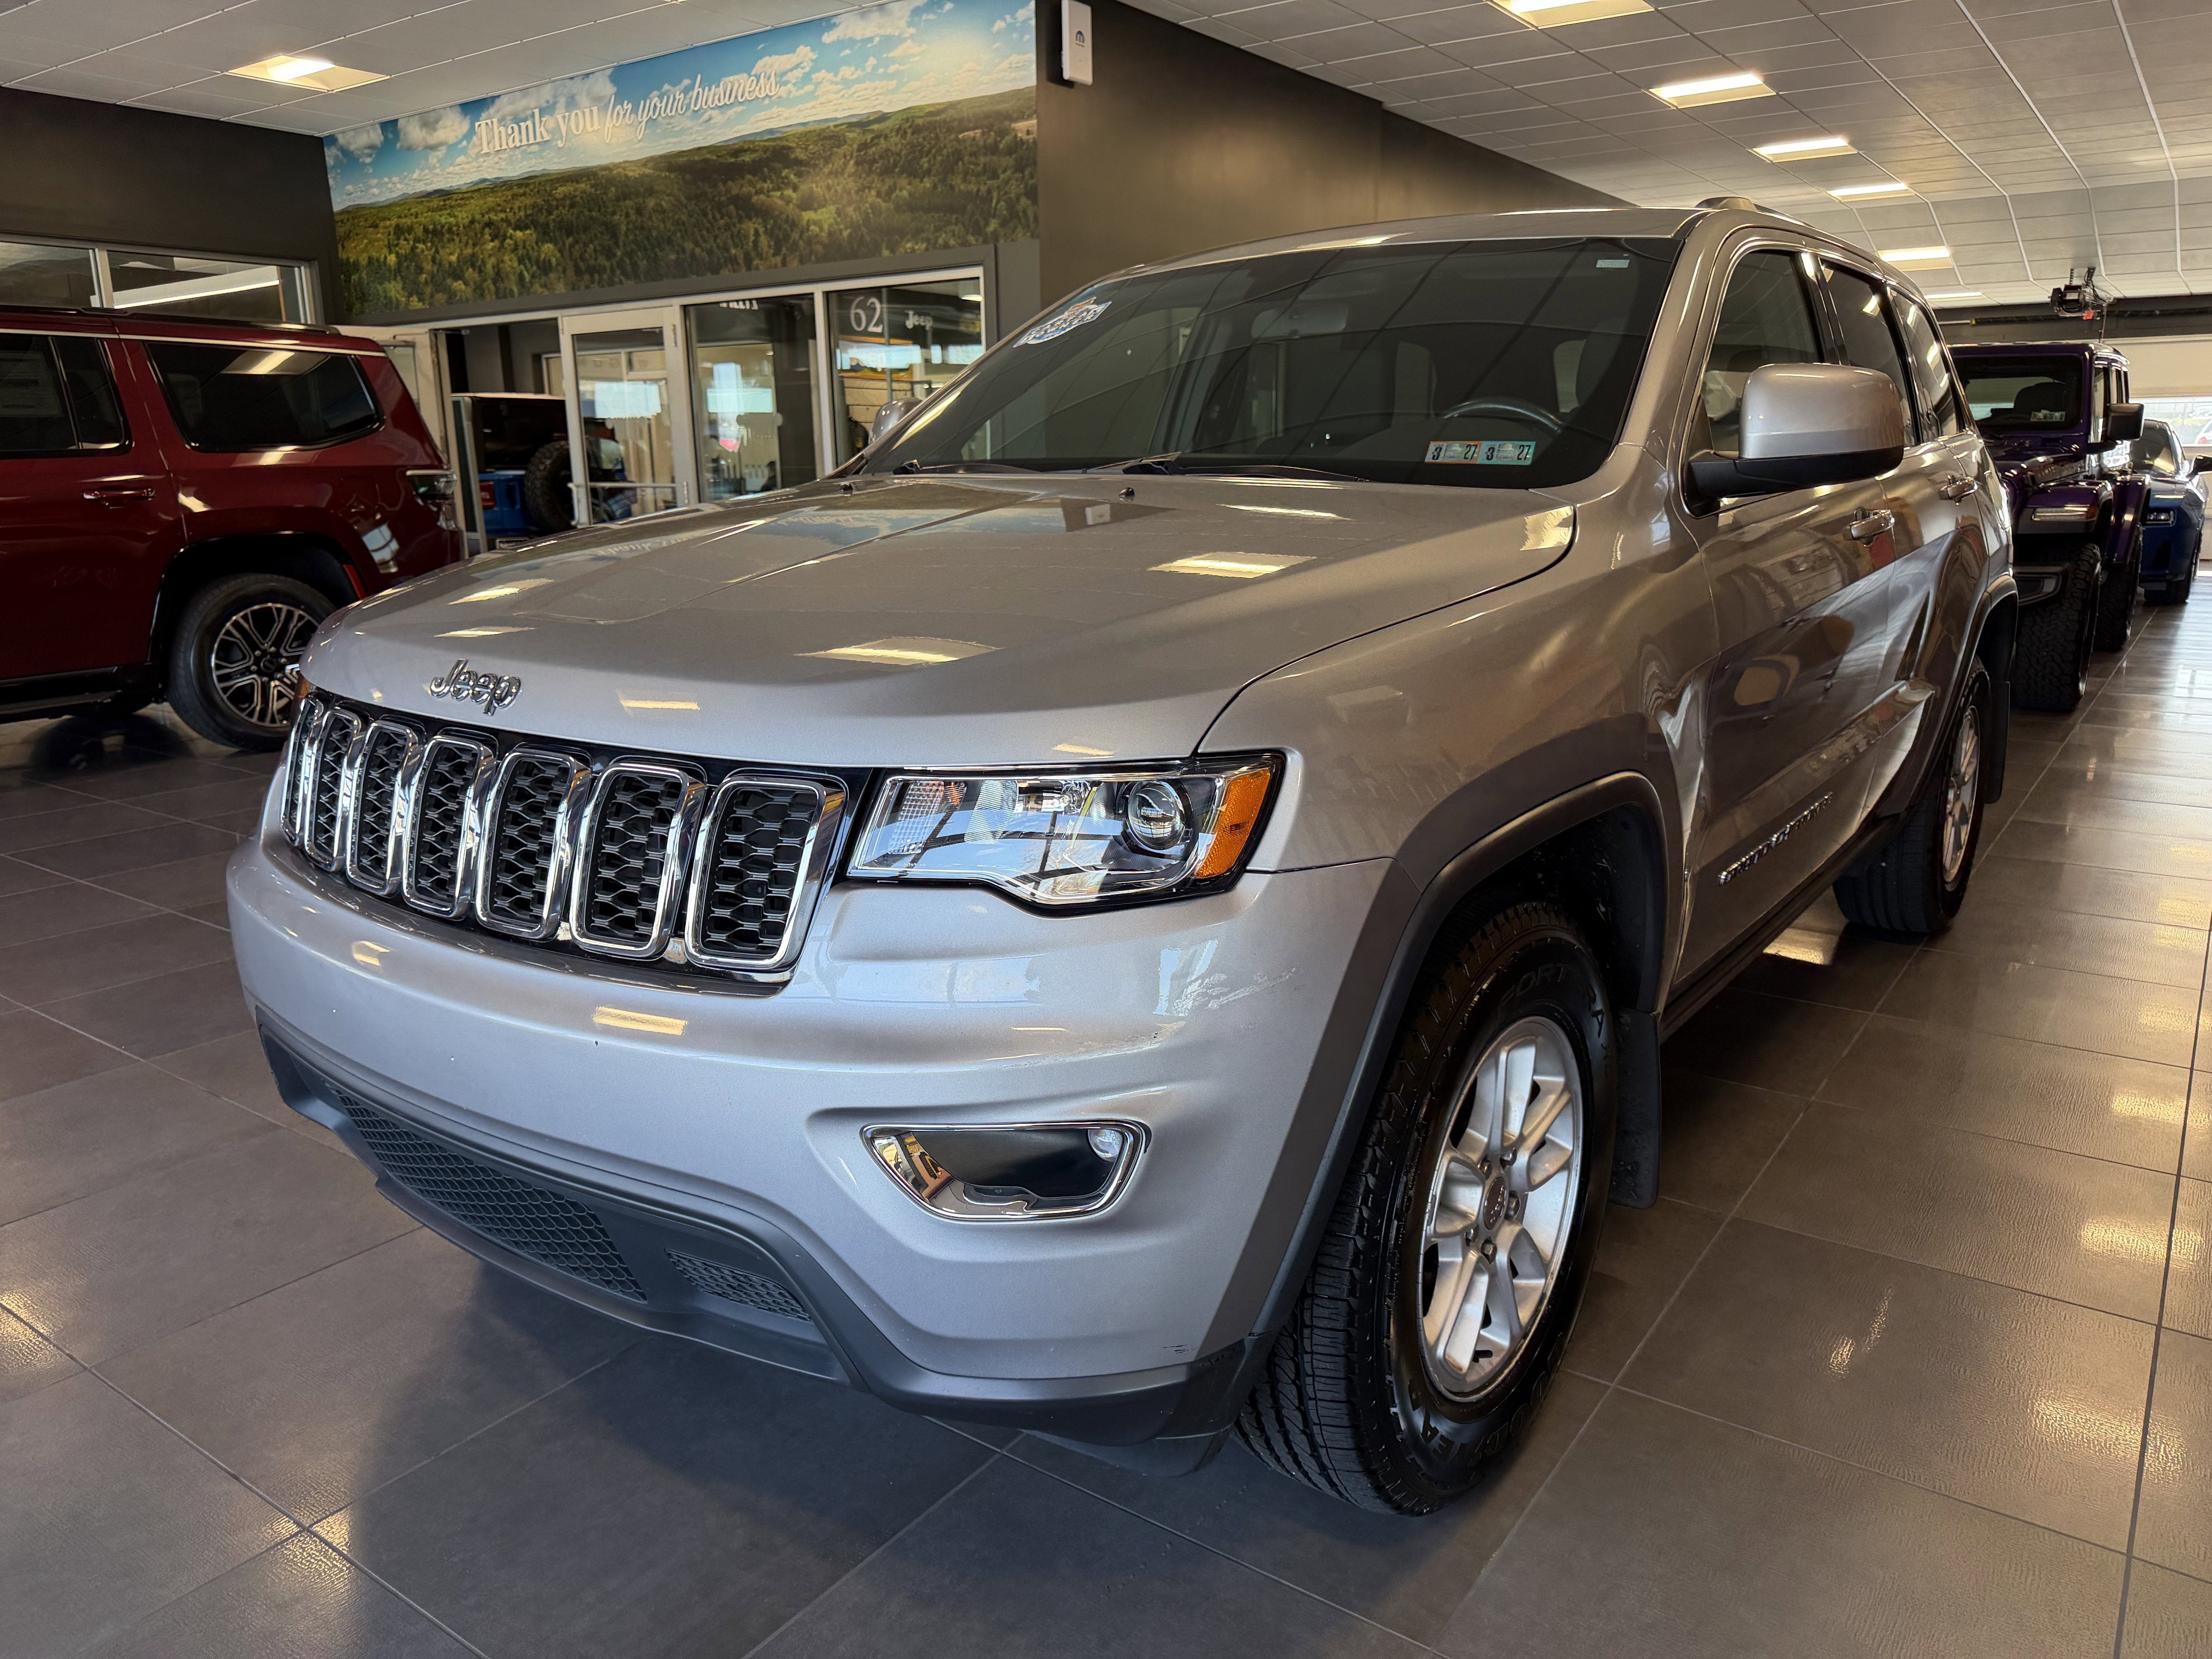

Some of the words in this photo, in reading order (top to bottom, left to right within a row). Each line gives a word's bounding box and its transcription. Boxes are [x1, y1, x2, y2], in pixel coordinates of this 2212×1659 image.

[475, 108, 551, 154] Thank
[555, 106, 601, 148] you
[604, 94, 635, 144] for
[636, 90, 687, 141] your
[690, 70, 780, 111] business
[850, 296, 883, 333] 62
[1432, 447, 1442, 460] 3
[1463, 444, 1478, 460] 27
[1486, 447, 1495, 461] 3
[1516, 445, 1531, 460] 27
[429, 658, 522, 716] Jeep
